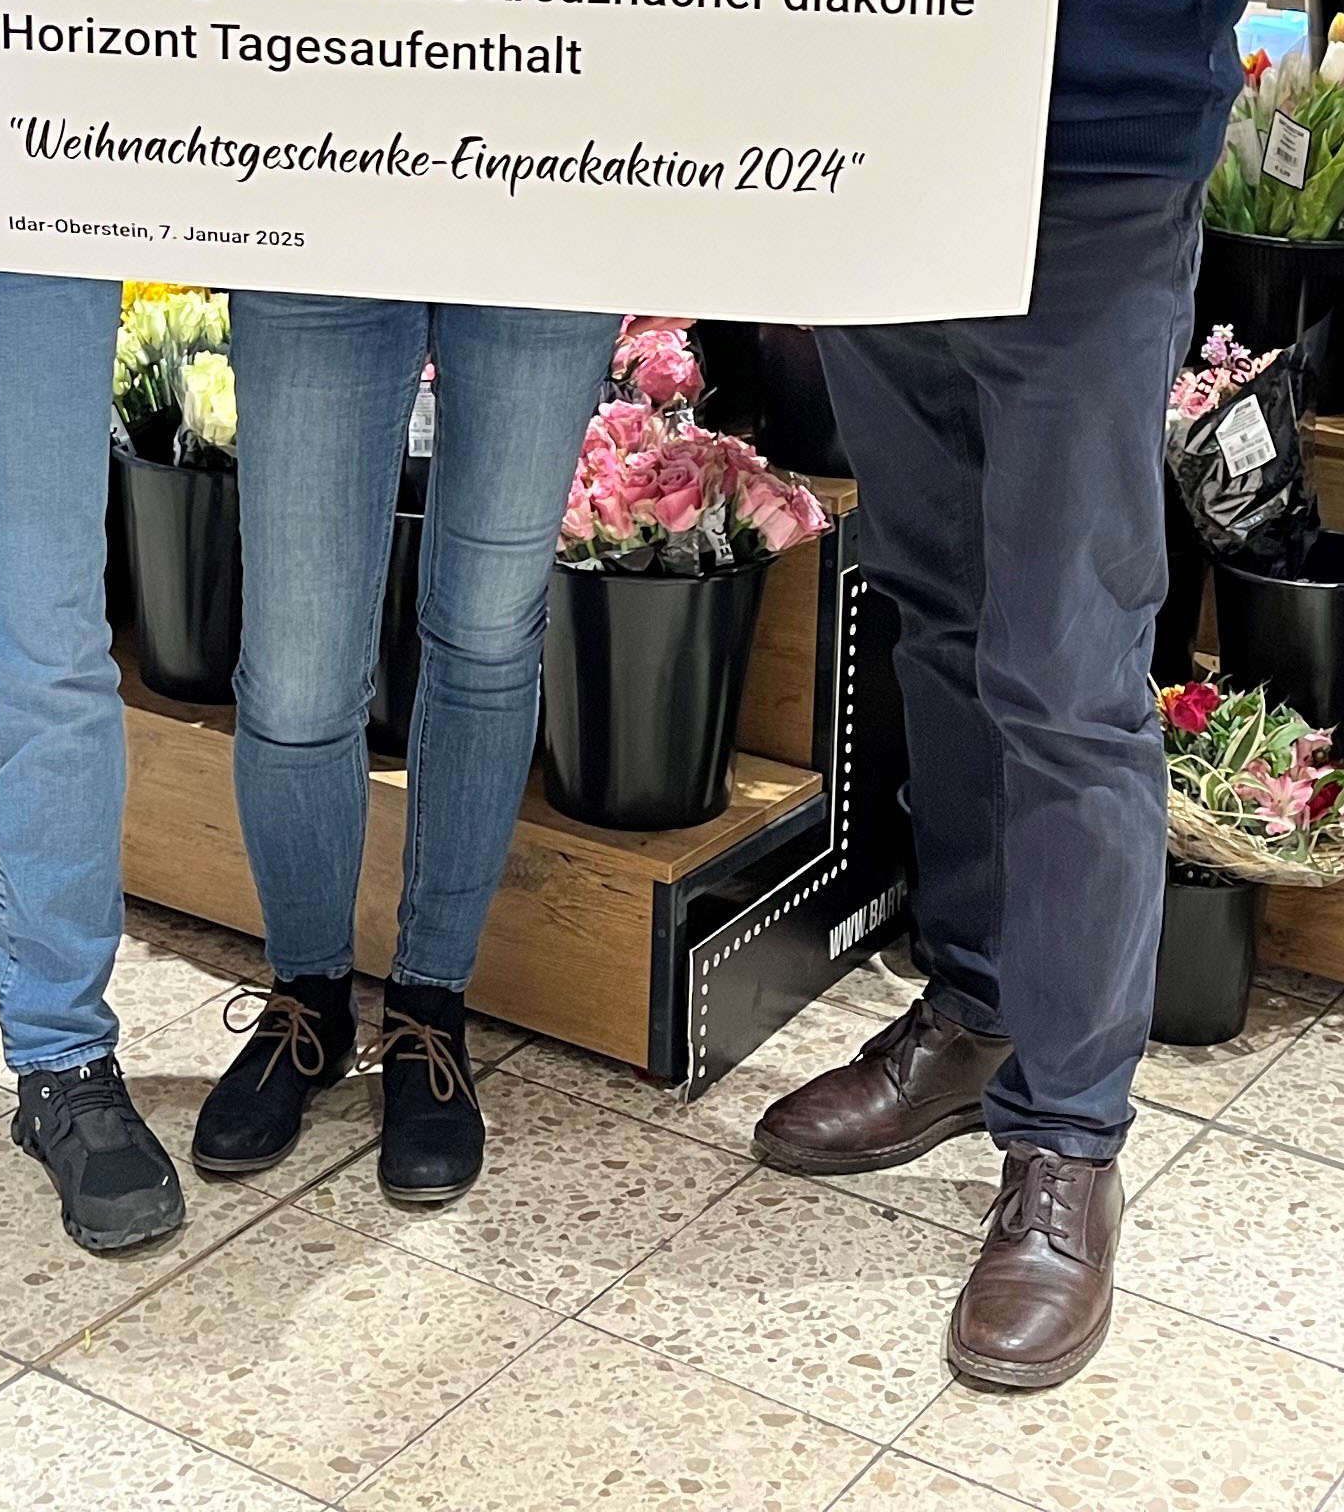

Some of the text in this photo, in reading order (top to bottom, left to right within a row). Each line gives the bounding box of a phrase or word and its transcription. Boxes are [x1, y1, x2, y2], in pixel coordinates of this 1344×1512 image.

[1, 13, 583, 74] Horizont Tagesaufenthalt
[8, 215, 306, 248] Idar-Oberstein, 7. Januar 2025
[829, 879, 907, 961] WWW.BART
